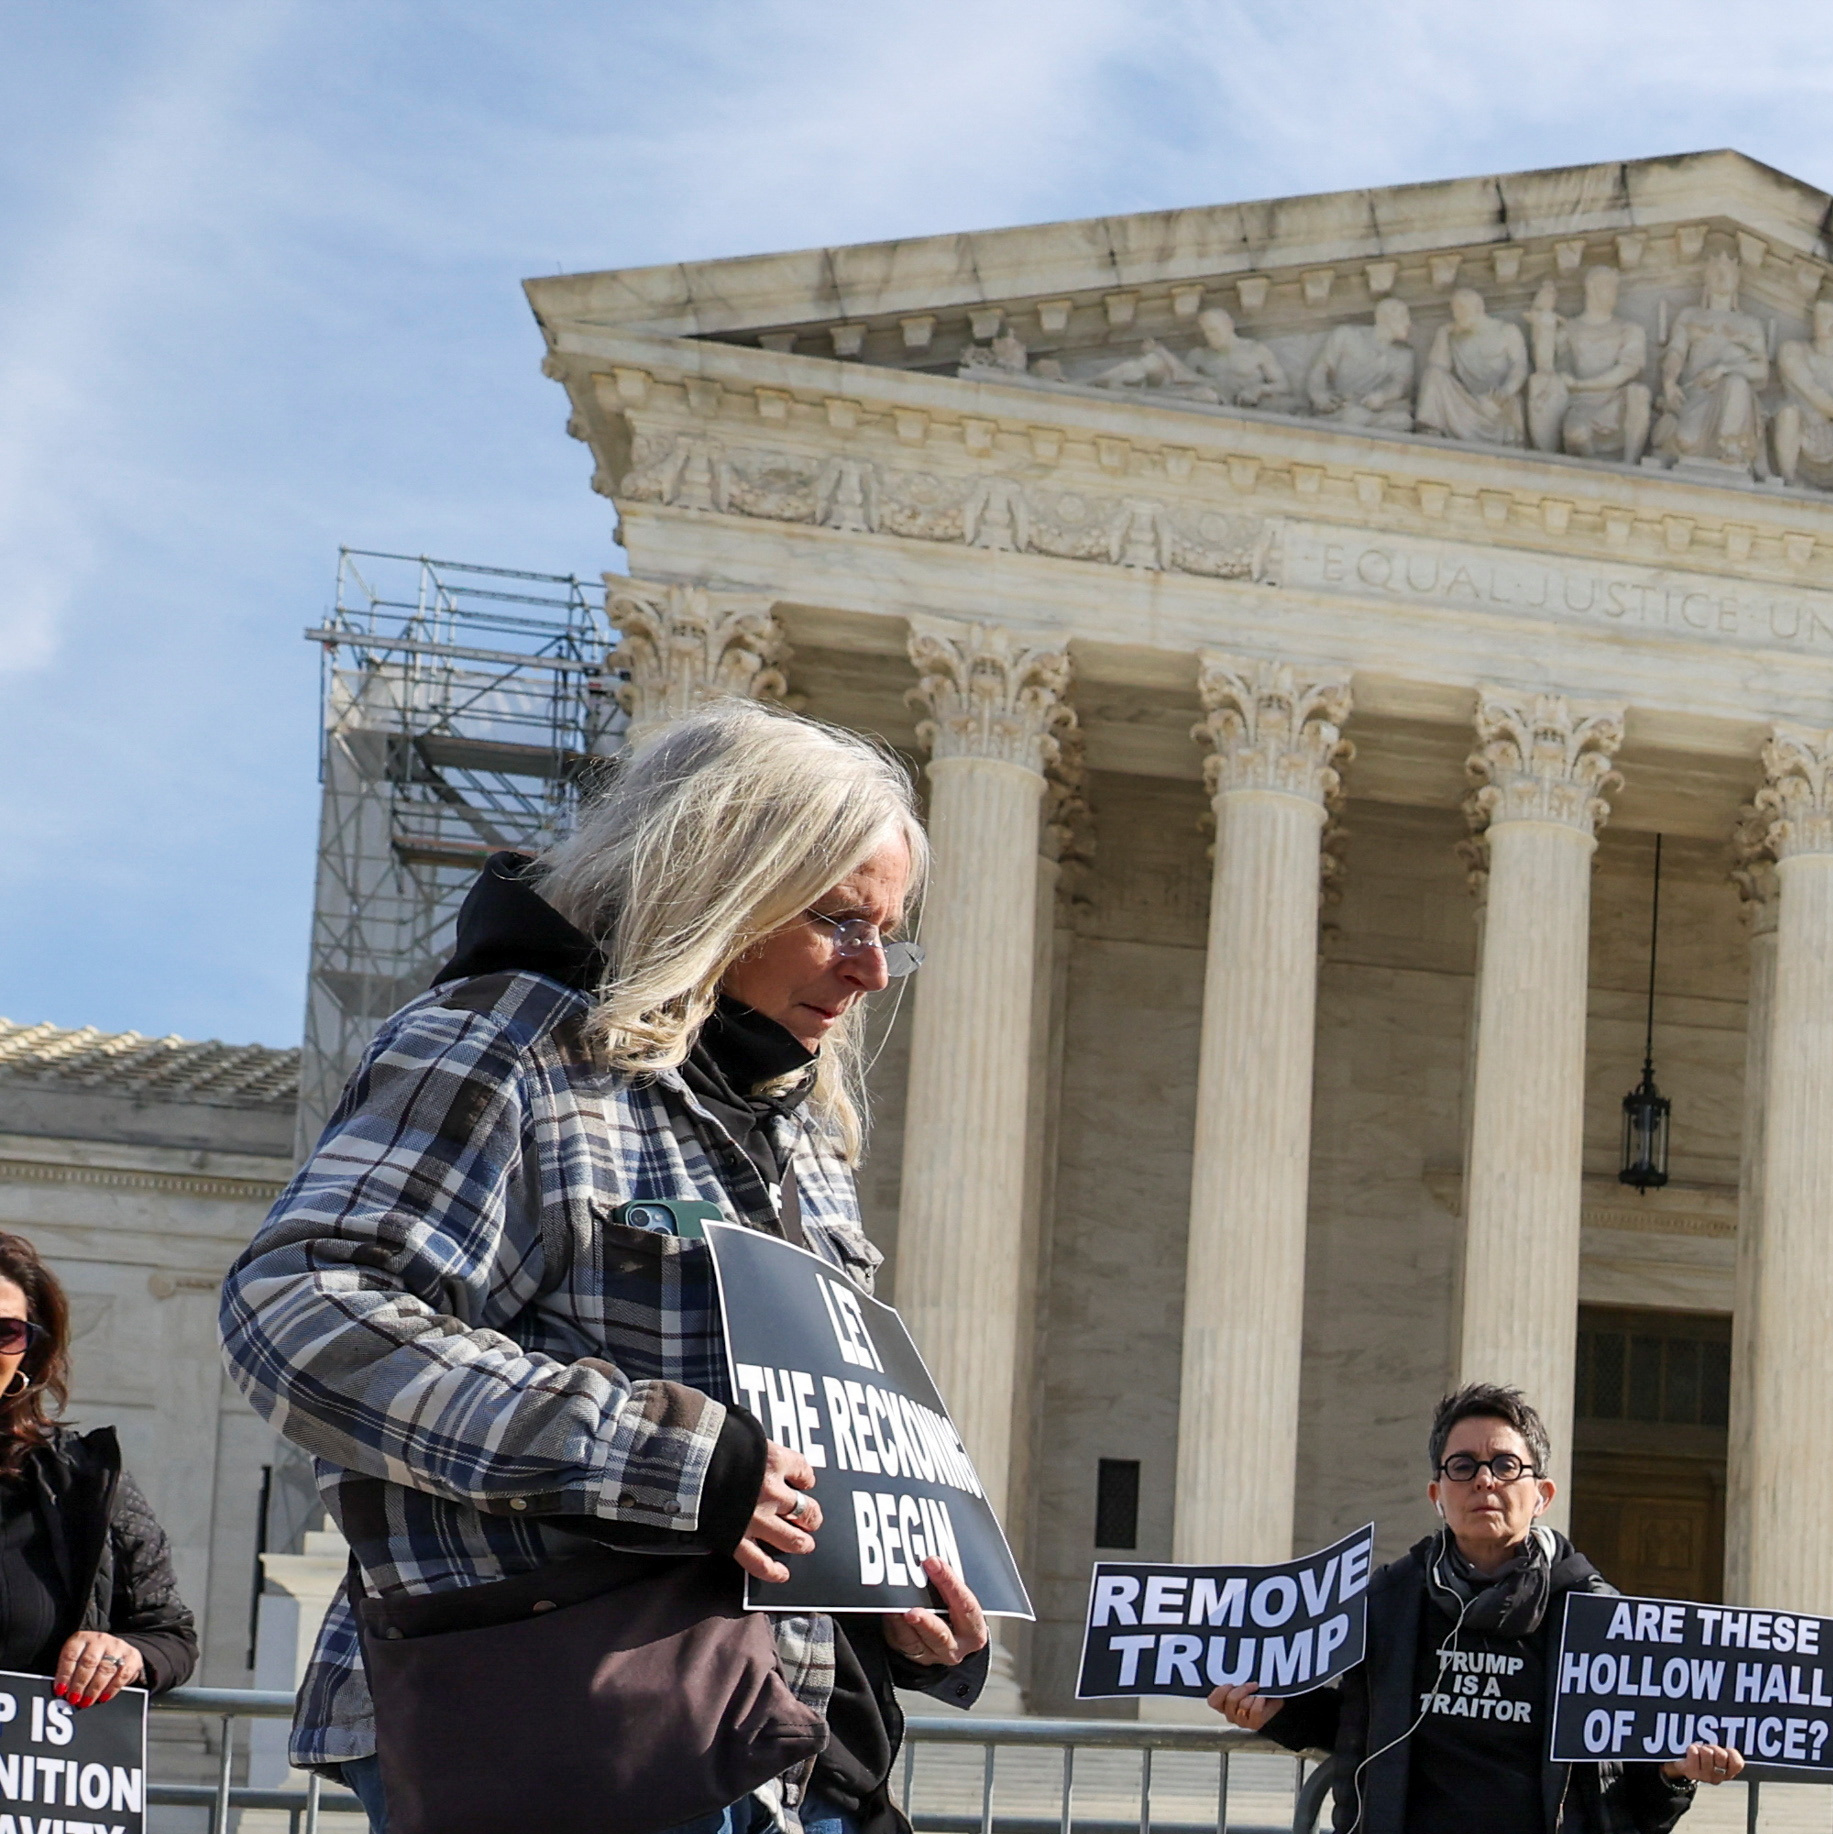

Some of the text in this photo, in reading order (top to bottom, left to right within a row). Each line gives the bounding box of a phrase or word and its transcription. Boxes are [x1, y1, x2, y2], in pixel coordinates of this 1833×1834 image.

[1322, 543, 1510, 603] EQUAL
[1525, 565, 1739, 633] JUSTICE
[815, 1273, 885, 1373] LET
[736, 1363, 983, 1499] THE RECKONING
[852, 1490, 966, 1588] BEGIN
[1092, 1538, 1370, 1628] REMOVE
[1109, 1613, 1349, 1688] TRUMP
[1606, 1602, 1820, 1655] ARE THESE
[1436, 1649, 1524, 1675] TRUMP
[1453, 1674, 1501, 1697] IS A
[1560, 1652, 1726, 1701] HOLLOW
[1420, 1693, 1532, 1723] TRAITOR
[1583, 1709, 1829, 1761] OF JUSTICE?
